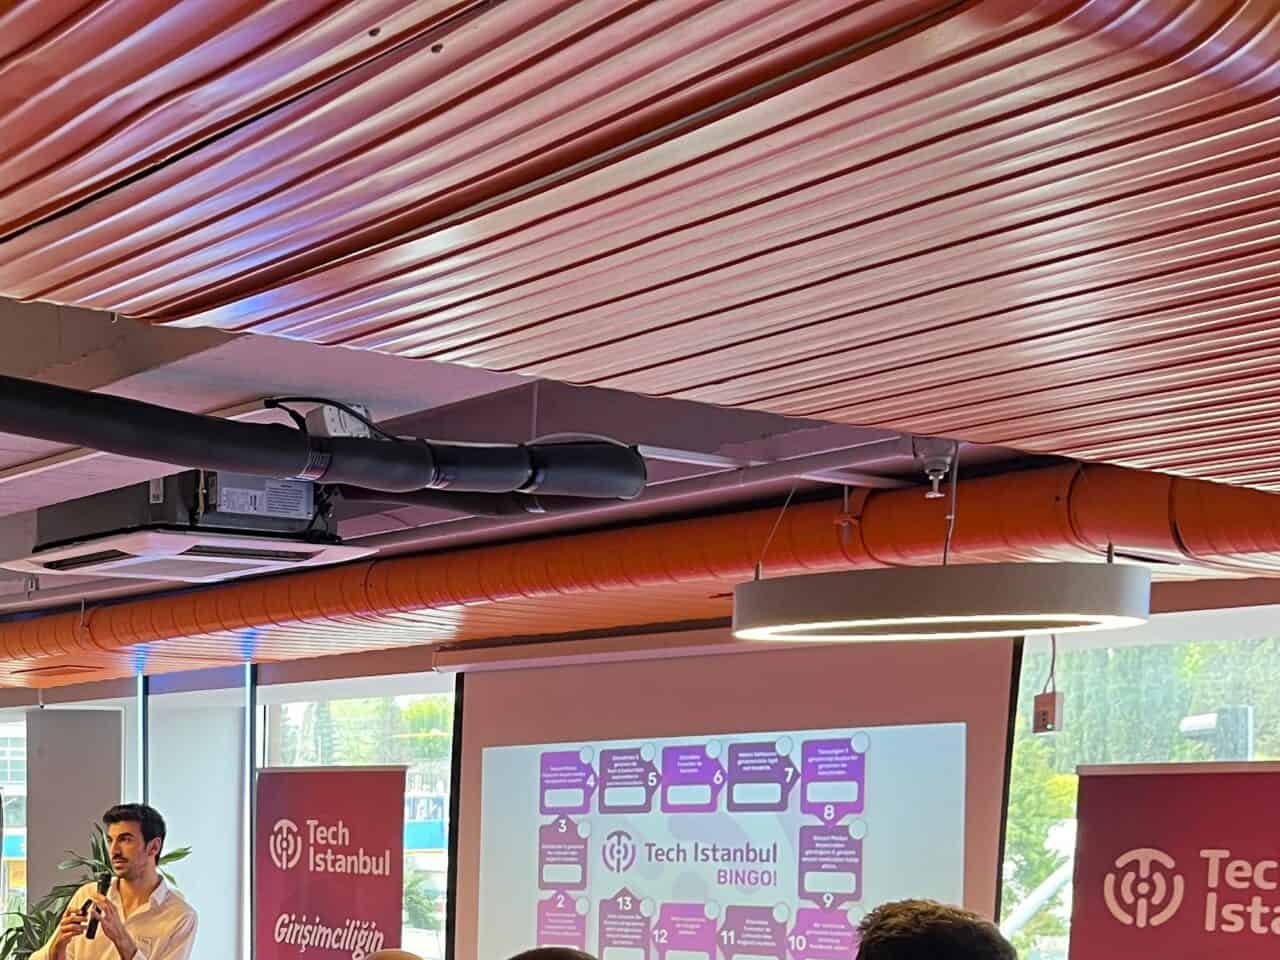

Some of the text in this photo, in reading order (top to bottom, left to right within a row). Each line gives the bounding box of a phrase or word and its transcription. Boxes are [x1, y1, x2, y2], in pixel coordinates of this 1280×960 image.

[586, 773, 595, 787] 4
[647, 771, 657, 786] 5
[713, 769, 724, 785] 6
[784, 767, 794, 783] 7
[823, 804, 835, 820] 8
[306, 819, 350, 846] Tech
[558, 819, 567, 832] 3
[645, 842, 687, 863] Tech
[694, 841, 777, 864] Istanbul
[309, 846, 390, 876] Istanbul
[717, 869, 777, 887] BINGO!
[556, 894, 565, 908] 2
[617, 896, 632, 911] 13
[823, 892, 834, 908] 9
[653, 929, 668, 944] 12
[721, 930, 735, 945] 11
[788, 935, 807, 951] 10
